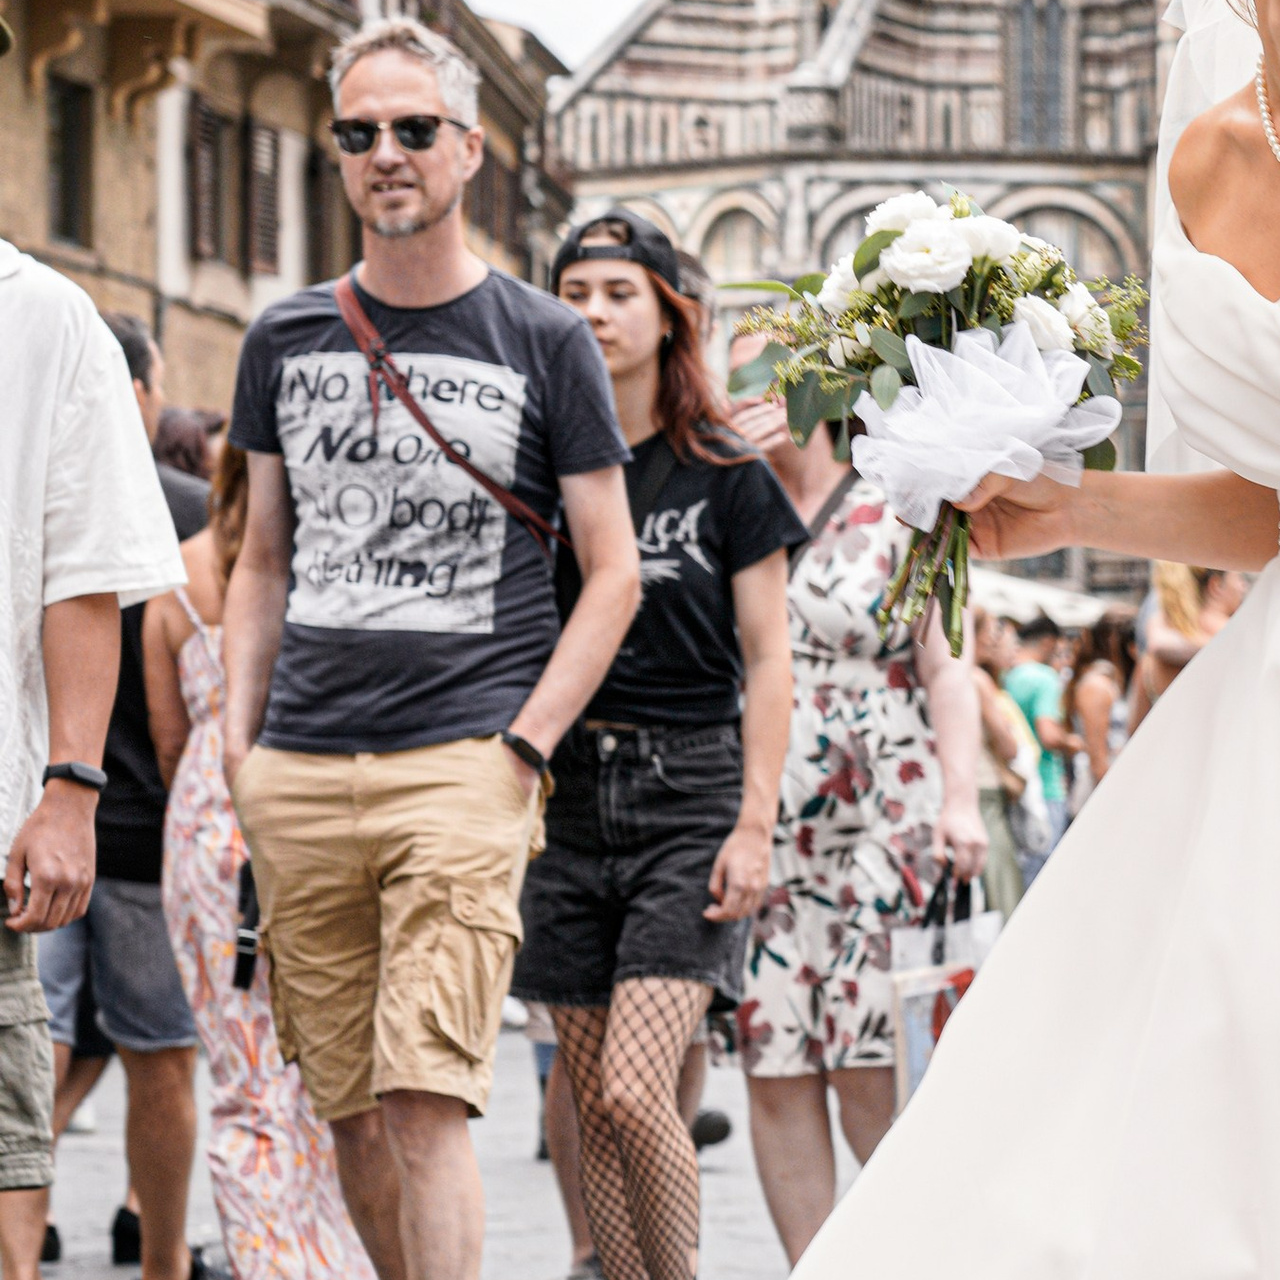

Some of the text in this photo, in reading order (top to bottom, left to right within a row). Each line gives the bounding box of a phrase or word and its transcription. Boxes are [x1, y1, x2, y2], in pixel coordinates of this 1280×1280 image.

[288, 364, 505, 411] No where
[303, 426, 378, 463] No
[388, 486, 490, 539] body
